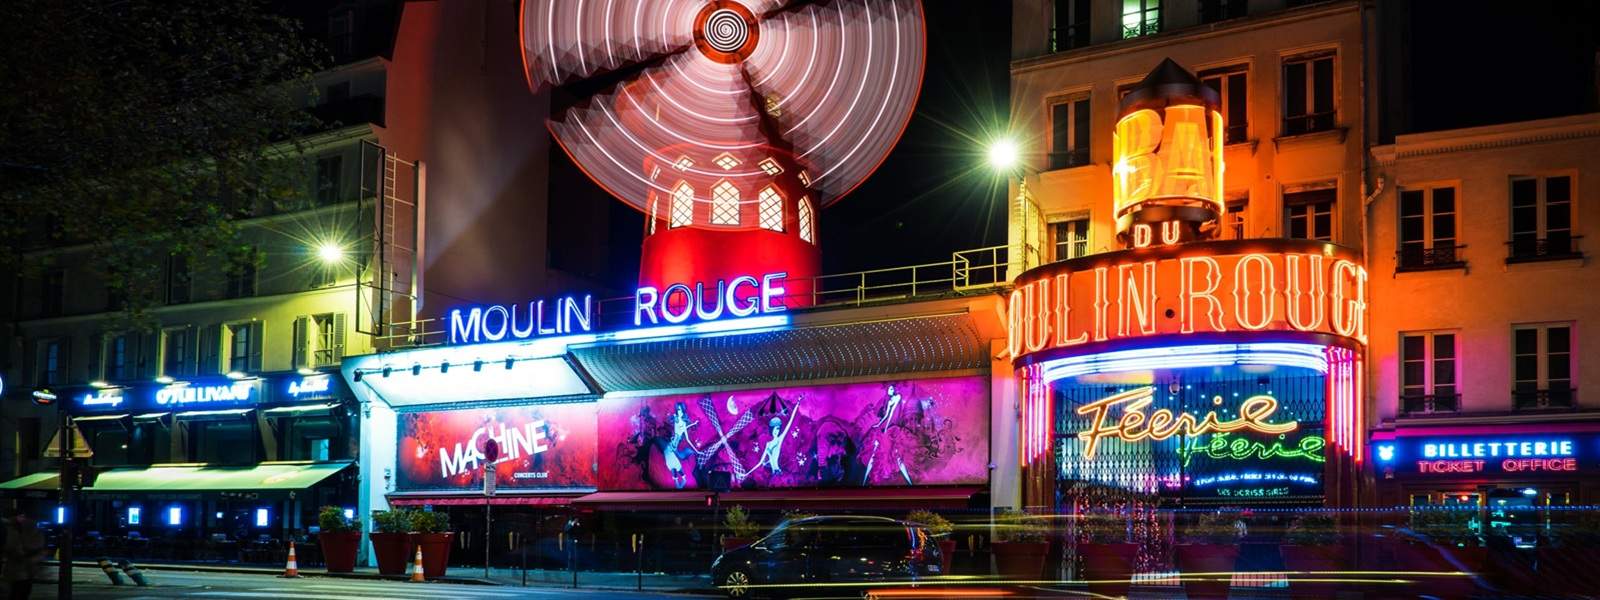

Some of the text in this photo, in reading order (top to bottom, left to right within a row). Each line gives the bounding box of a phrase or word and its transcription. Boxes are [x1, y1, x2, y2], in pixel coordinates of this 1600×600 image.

[1134, 220, 1180, 248] DU
[451, 271, 787, 344] MOULIN ROUGE
[1008, 260, 1157, 362] OULIN
[439, 420, 548, 478] MACHINE
[1078, 385, 1297, 460] Féerie
[1424, 441, 1572, 457] BILLETTERIE
[1418, 458, 1577, 473] TICKET OFFICE
